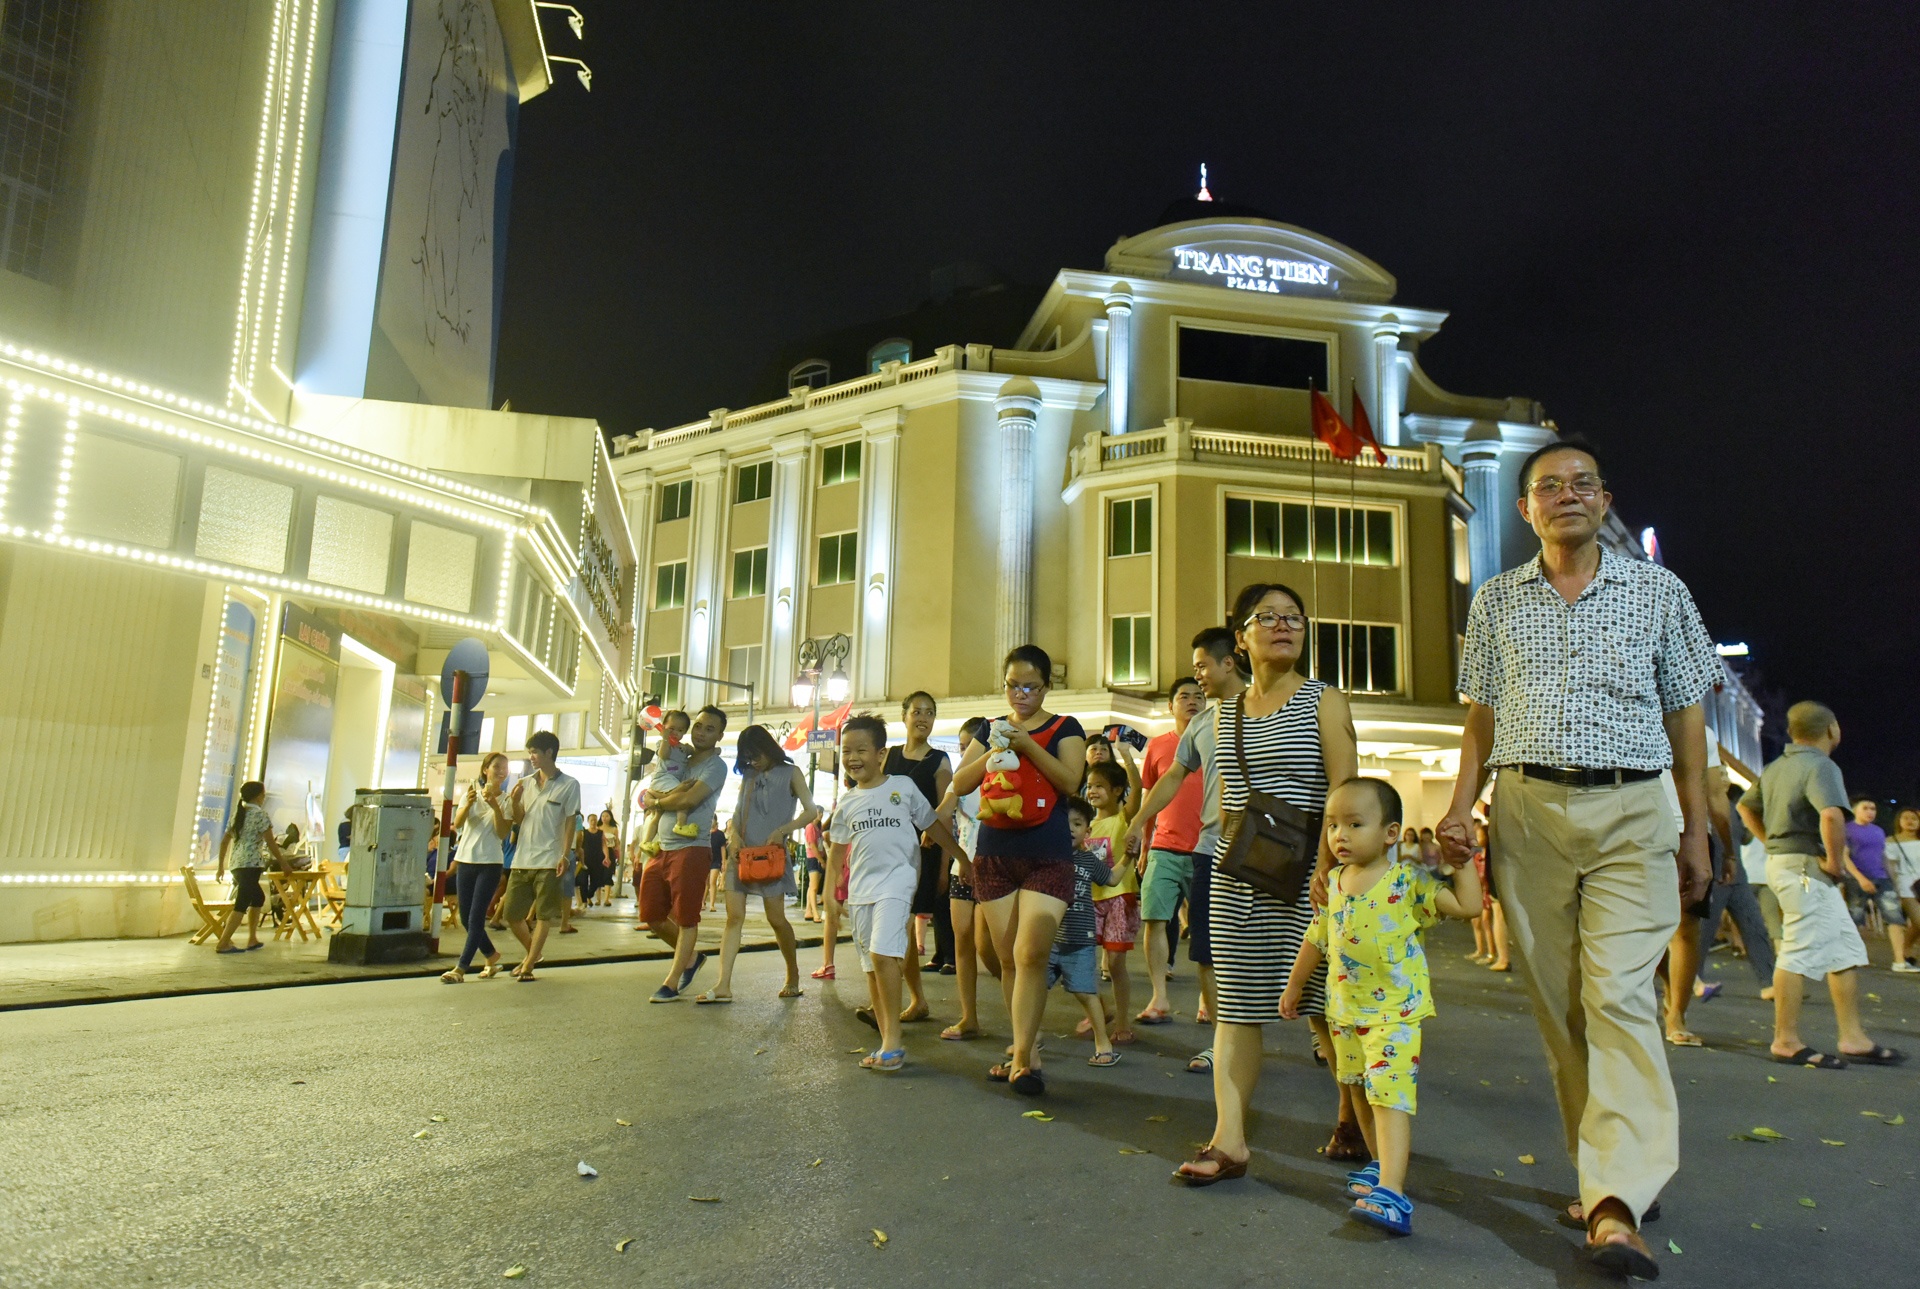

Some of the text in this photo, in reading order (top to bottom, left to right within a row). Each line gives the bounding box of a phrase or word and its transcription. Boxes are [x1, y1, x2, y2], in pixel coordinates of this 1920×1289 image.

[1175, 249, 1264, 278] TRANG
[1227, 276, 1280, 293] PLAZA
[868, 808, 882, 816] Fly
[852, 816, 901, 832] Emirates
